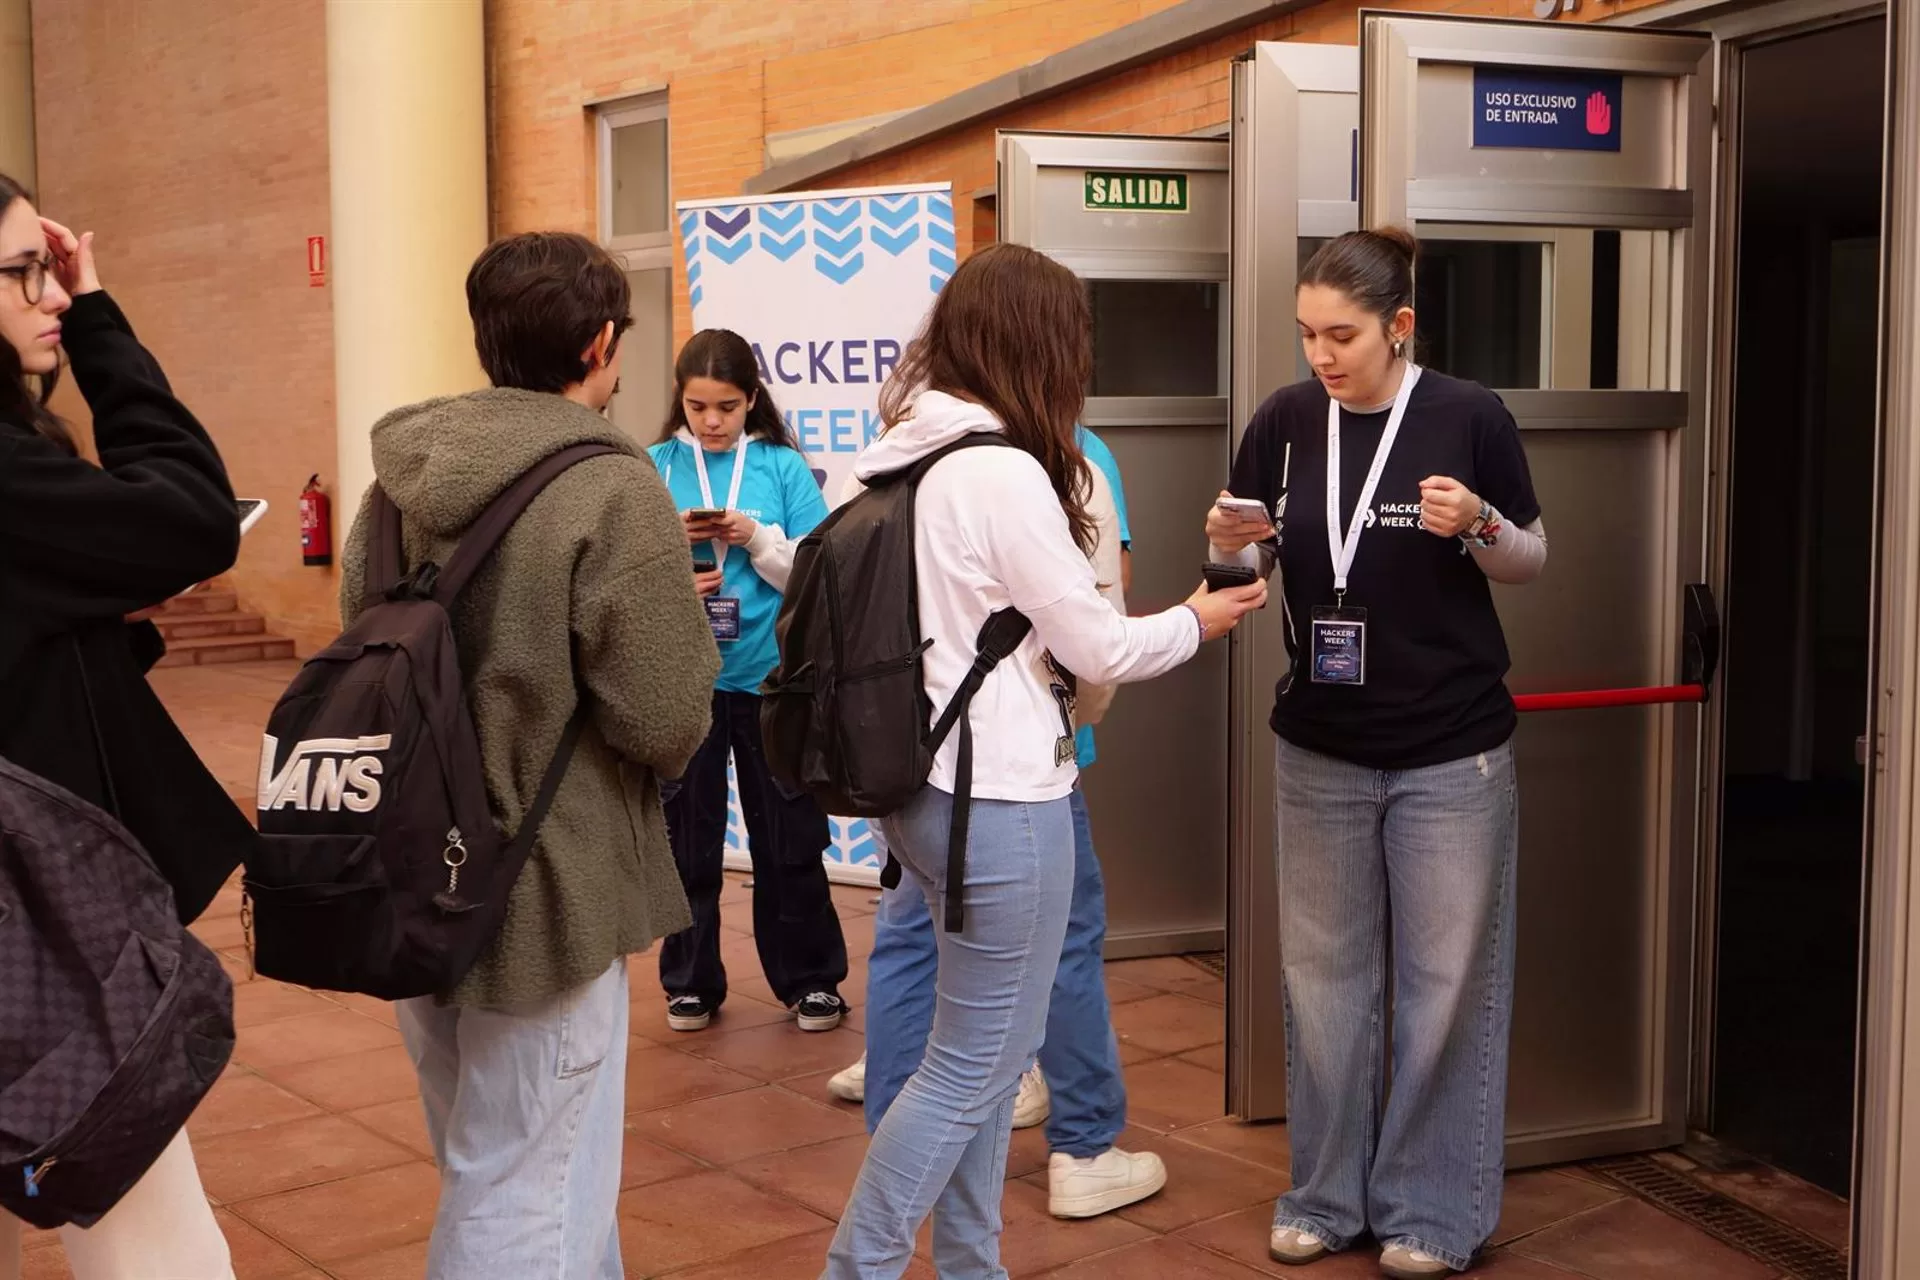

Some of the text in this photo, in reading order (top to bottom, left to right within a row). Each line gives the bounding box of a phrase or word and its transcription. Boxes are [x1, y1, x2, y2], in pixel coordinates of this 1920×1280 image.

[1486, 92, 1577, 109] USO EXCLUSIVO
[1486, 109, 1558, 124] DE ENTRADA
[1092, 177, 1180, 204] SALIDA
[752, 339, 900, 384] ACKER
[1380, 503, 1421, 513] HACKE
[1380, 516, 1414, 527] WEEK
[1320, 629, 1356, 637] HACKERS
[1324, 637, 1346, 645] WEEK
[257, 733, 392, 813] VANS
